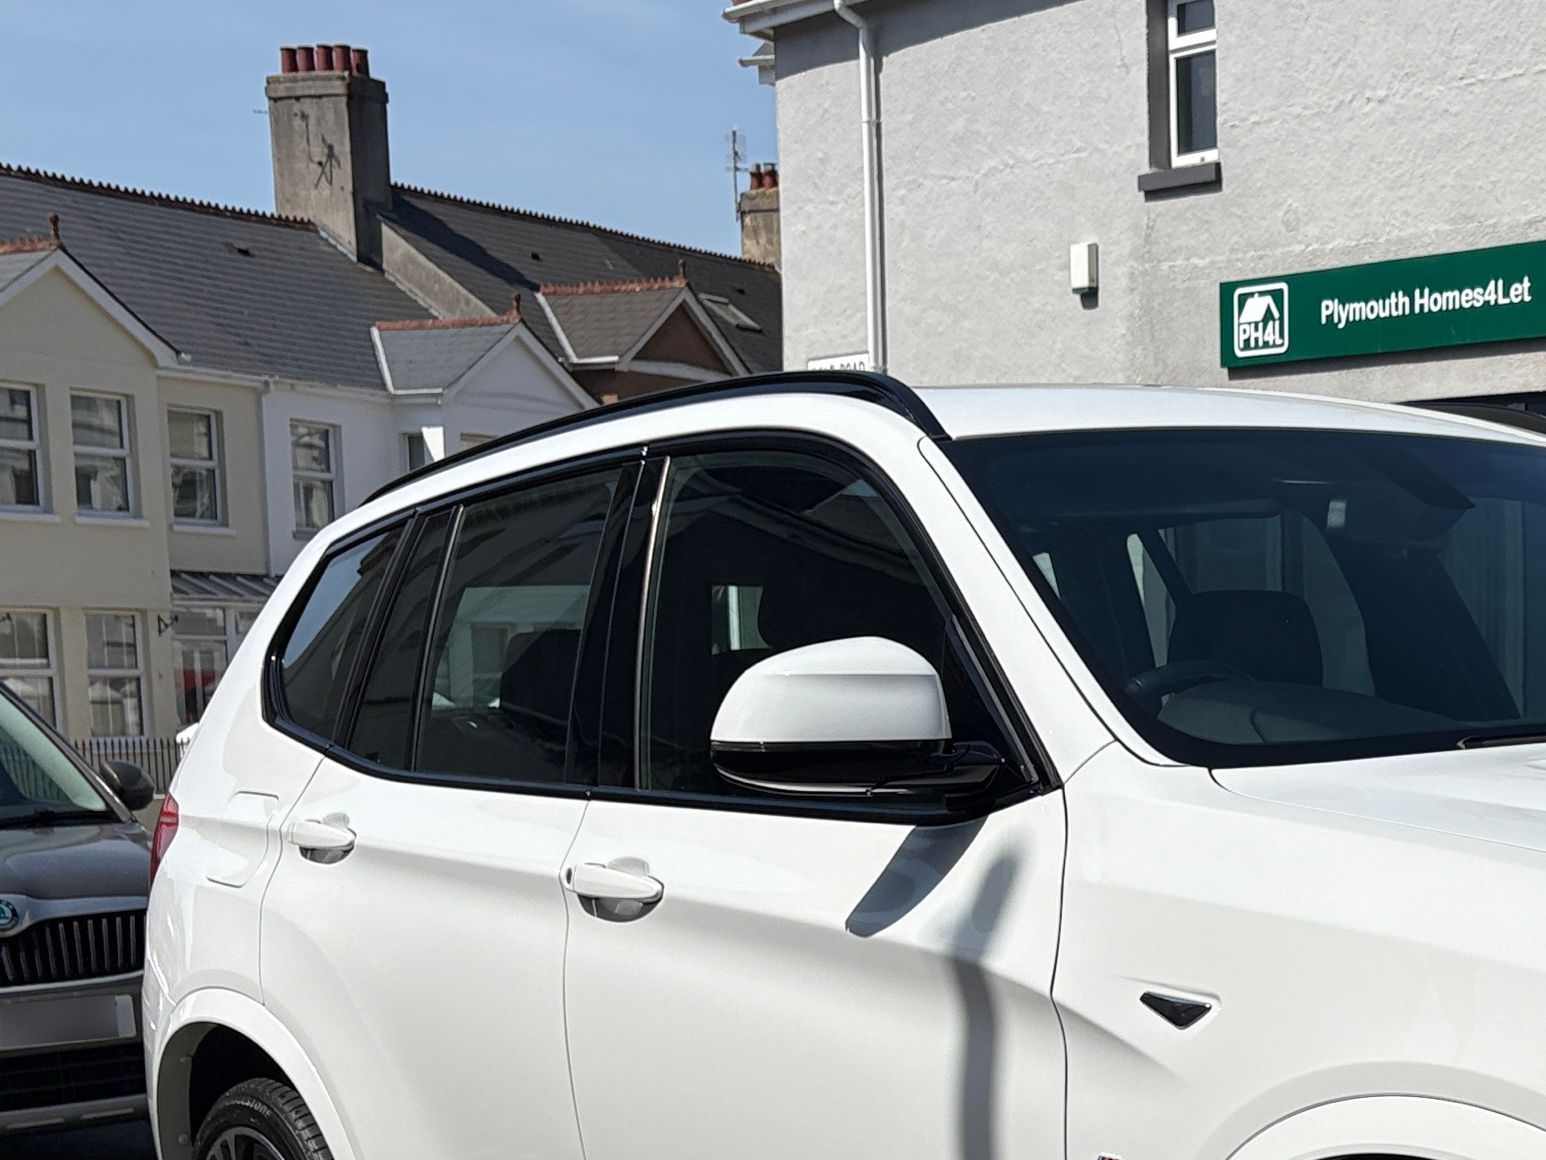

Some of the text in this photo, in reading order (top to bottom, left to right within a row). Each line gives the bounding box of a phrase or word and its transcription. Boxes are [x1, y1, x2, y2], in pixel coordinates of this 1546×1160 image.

[1320, 276, 1532, 329] Plymouth Homes4Let
[1238, 321, 1284, 349] PH4L
